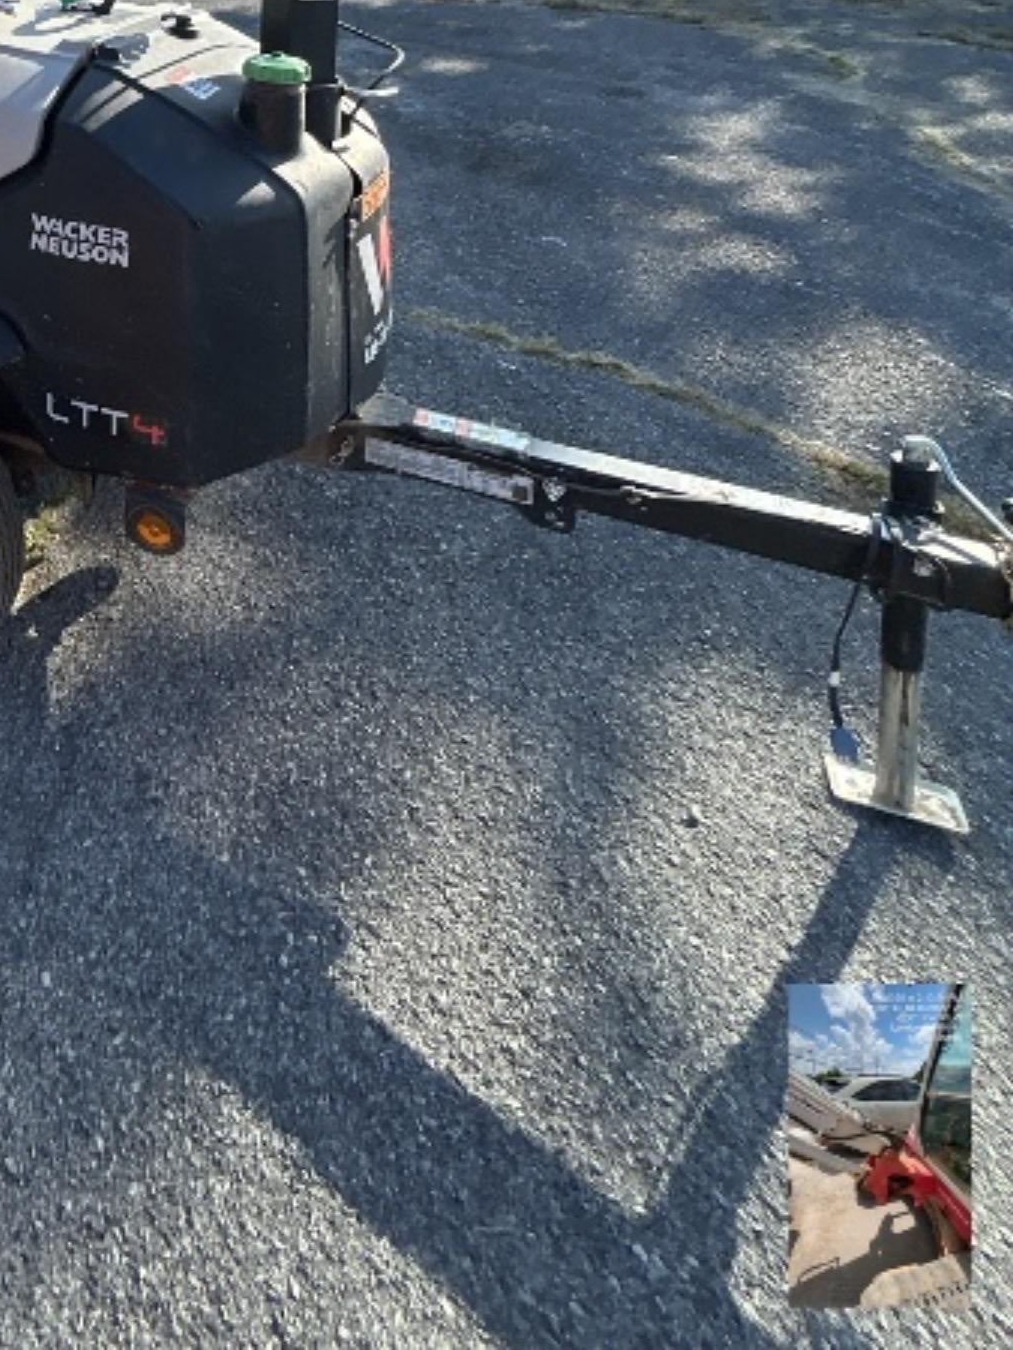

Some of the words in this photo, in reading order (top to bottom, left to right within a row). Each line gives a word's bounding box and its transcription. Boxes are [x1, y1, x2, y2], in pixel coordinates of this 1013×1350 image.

[31, 212, 129, 247] WACKER
[31, 232, 129, 268] NEUSON
[46, 392, 165, 445] LTT4
